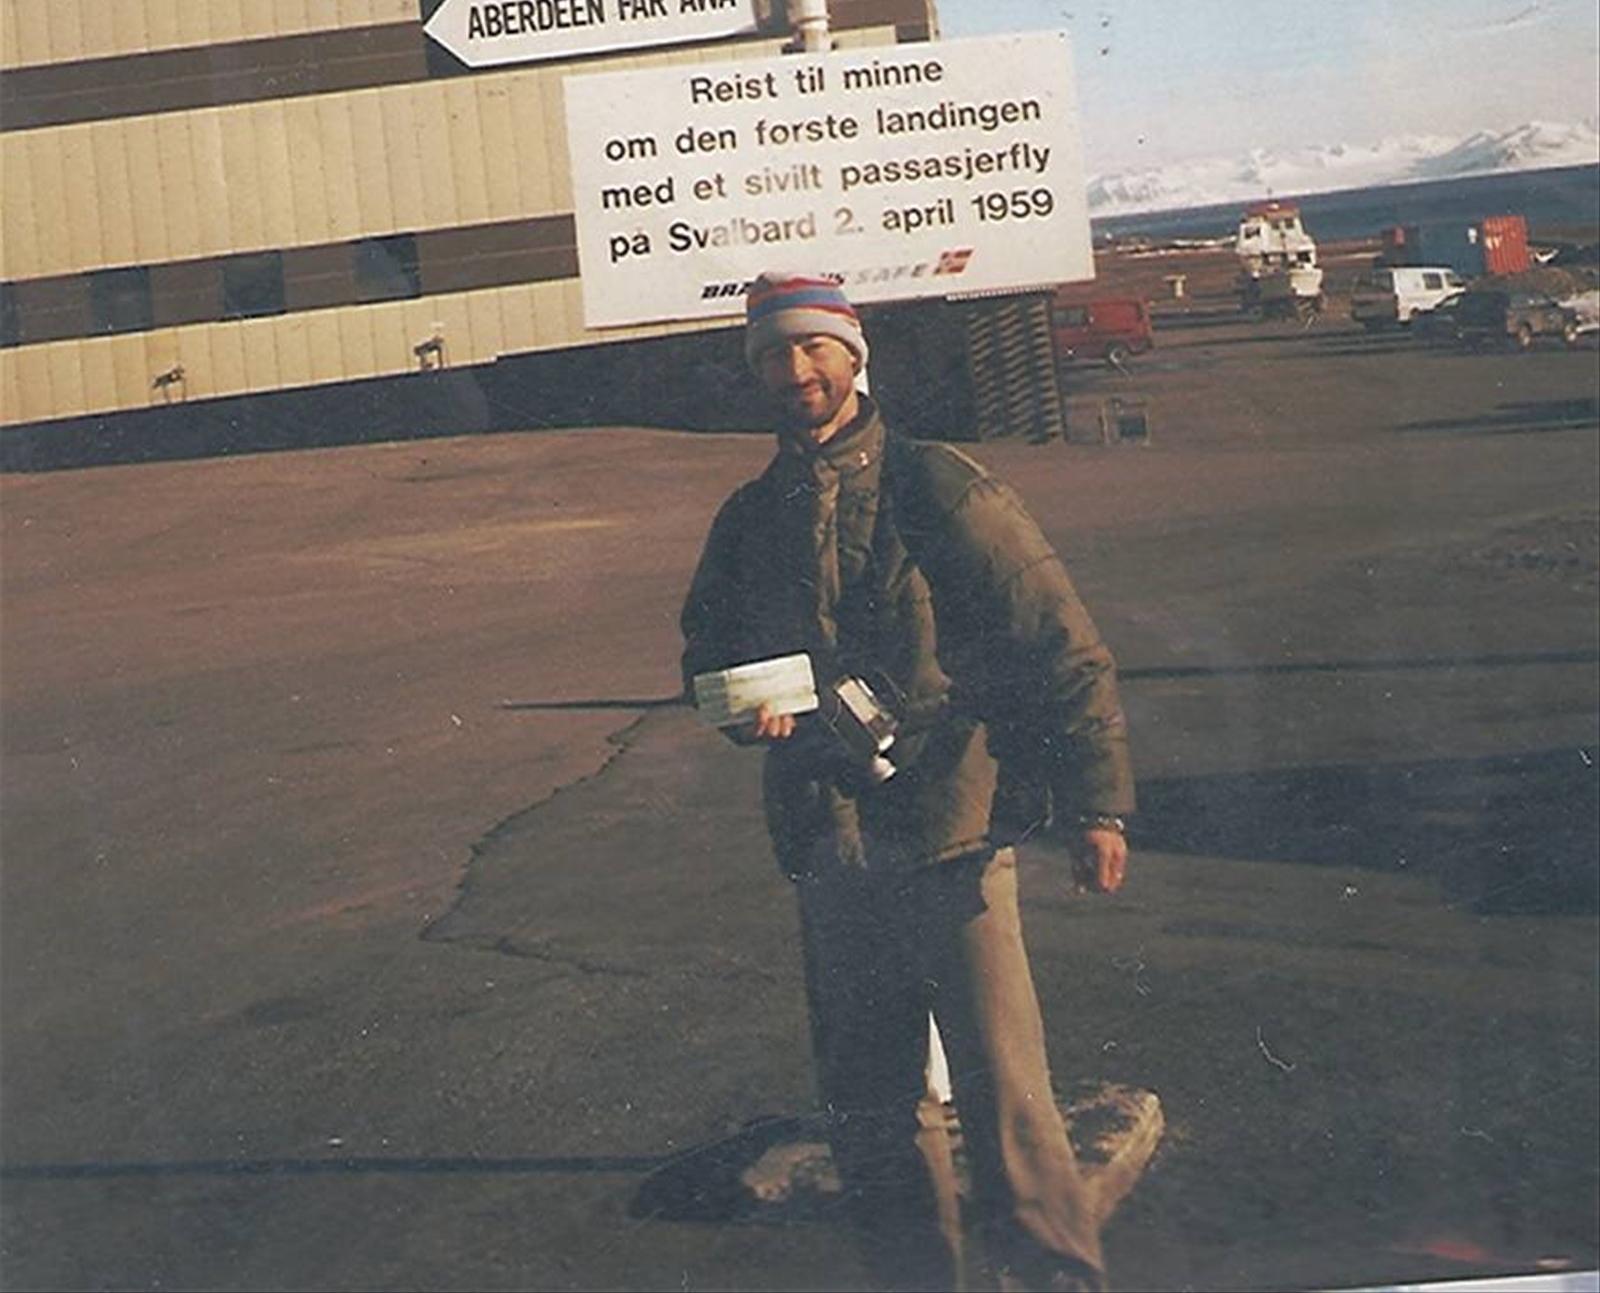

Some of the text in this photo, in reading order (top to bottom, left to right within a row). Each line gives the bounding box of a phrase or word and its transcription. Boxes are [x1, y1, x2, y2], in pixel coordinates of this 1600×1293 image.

[690, 59, 944, 104] Reist til minne
[605, 136, 657, 162] om
[675, 126, 738, 155] den
[876, 96, 1041, 135] landingen
[601, 144, 1051, 209] med et sivilt passasjerfly
[668, 212, 817, 252] Svalbard
[834, 206, 865, 236] 2.
[881, 198, 955, 235] april
[970, 188, 1055, 222] 1959
